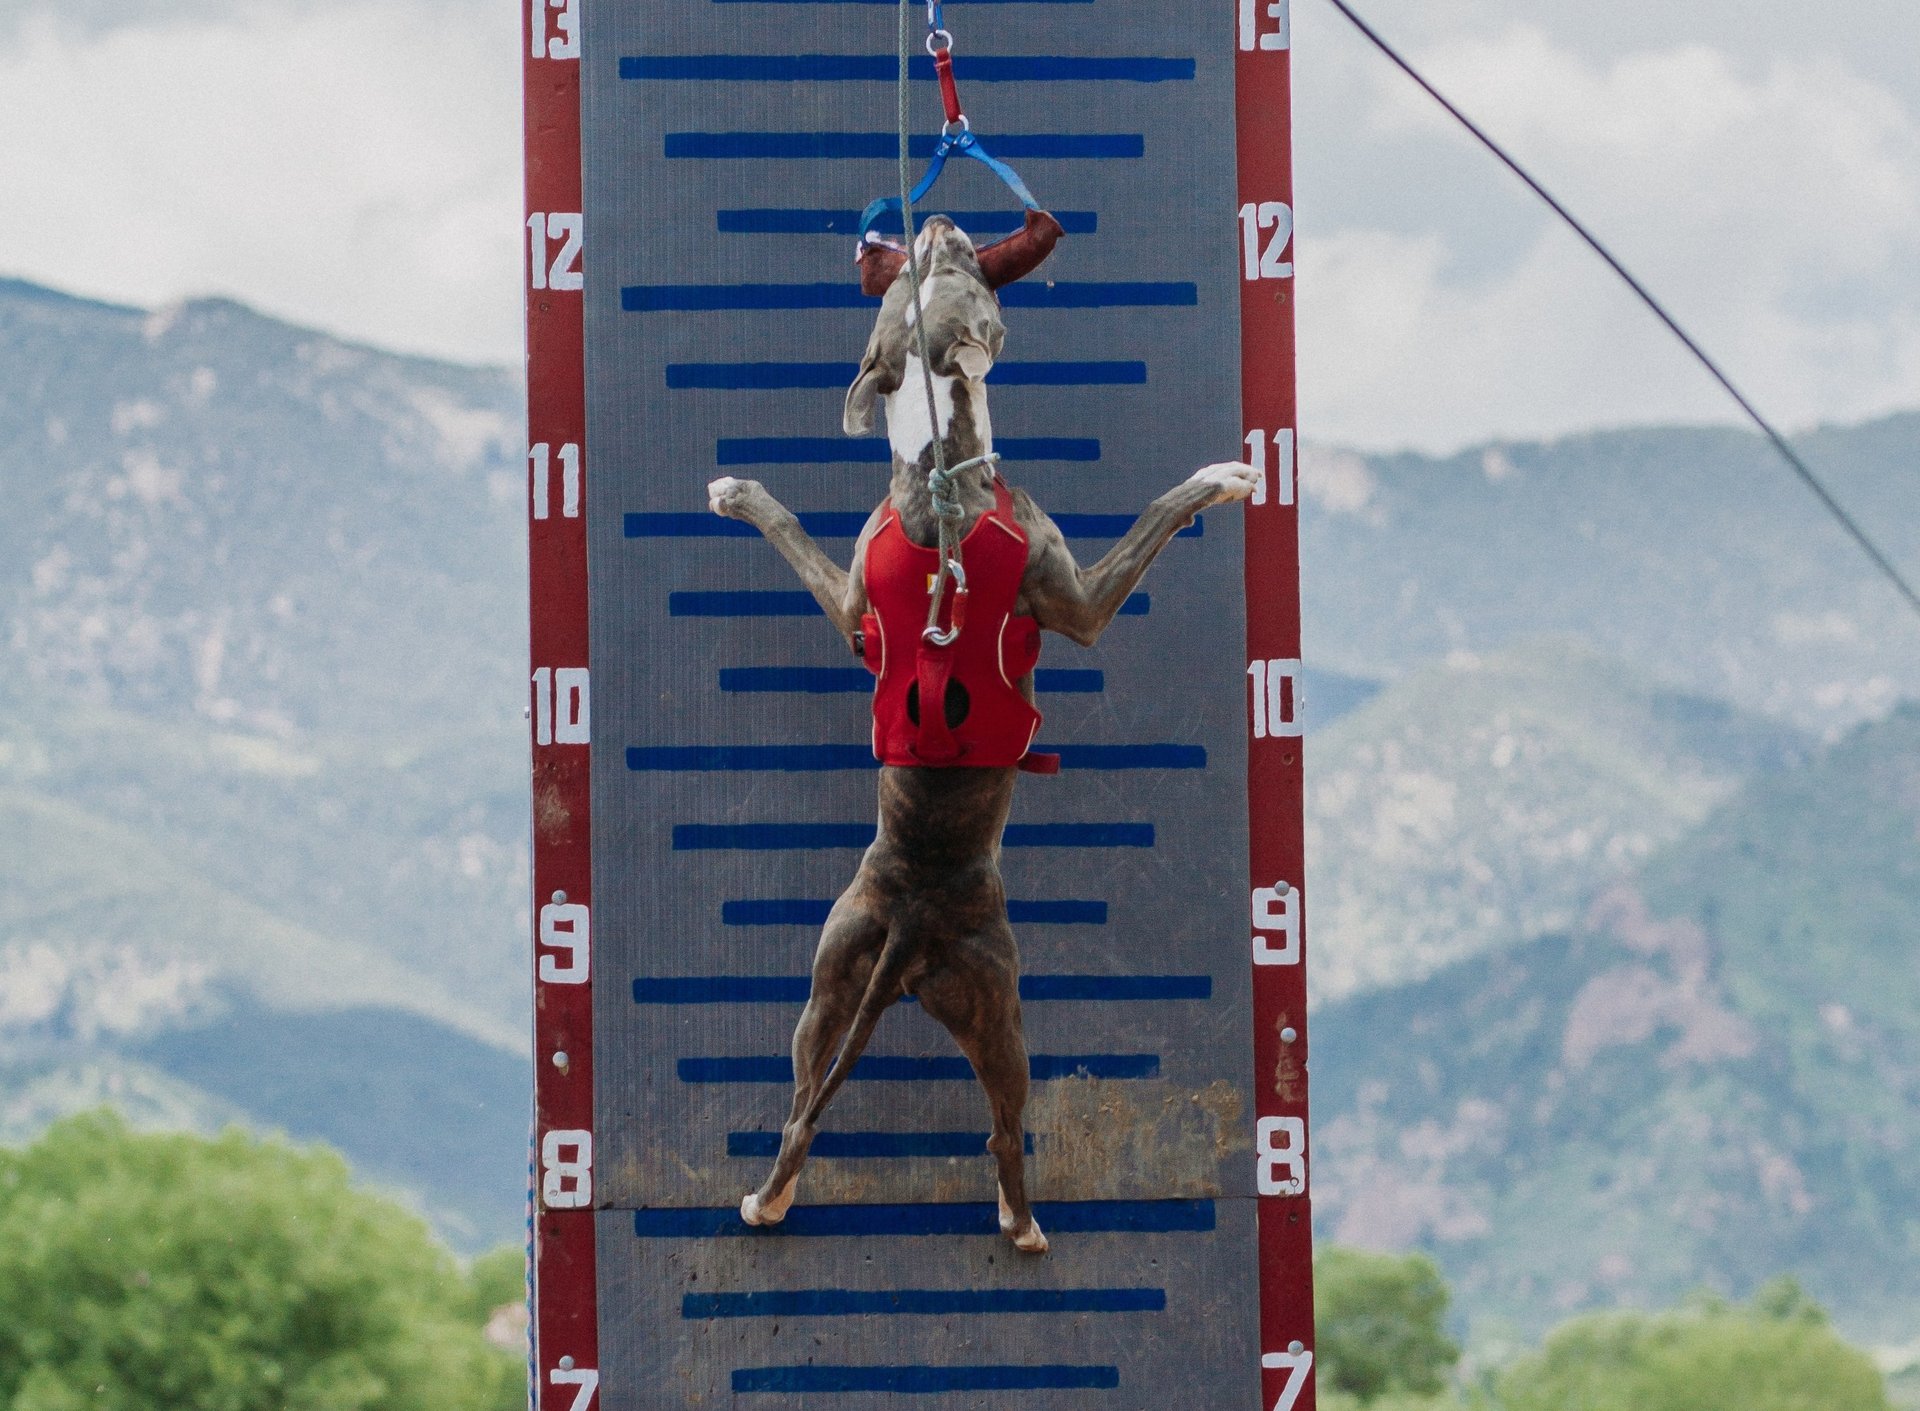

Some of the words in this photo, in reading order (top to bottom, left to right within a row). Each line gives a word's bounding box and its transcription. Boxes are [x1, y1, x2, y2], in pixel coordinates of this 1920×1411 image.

[532, 0, 580, 59] 13
[1239, 0, 1289, 51] 13
[527, 212, 582, 290] 12
[1239, 201, 1292, 280] 12
[529, 442, 579, 519] 11
[1244, 428, 1293, 505] 11
[532, 667, 590, 745] 10
[1247, 658, 1301, 739] 10
[539, 904, 590, 985] 9
[1252, 887, 1300, 965] 9
[542, 1129, 592, 1208] 8
[1256, 1116, 1306, 1196] 8
[1261, 1350, 1313, 1411] 7
